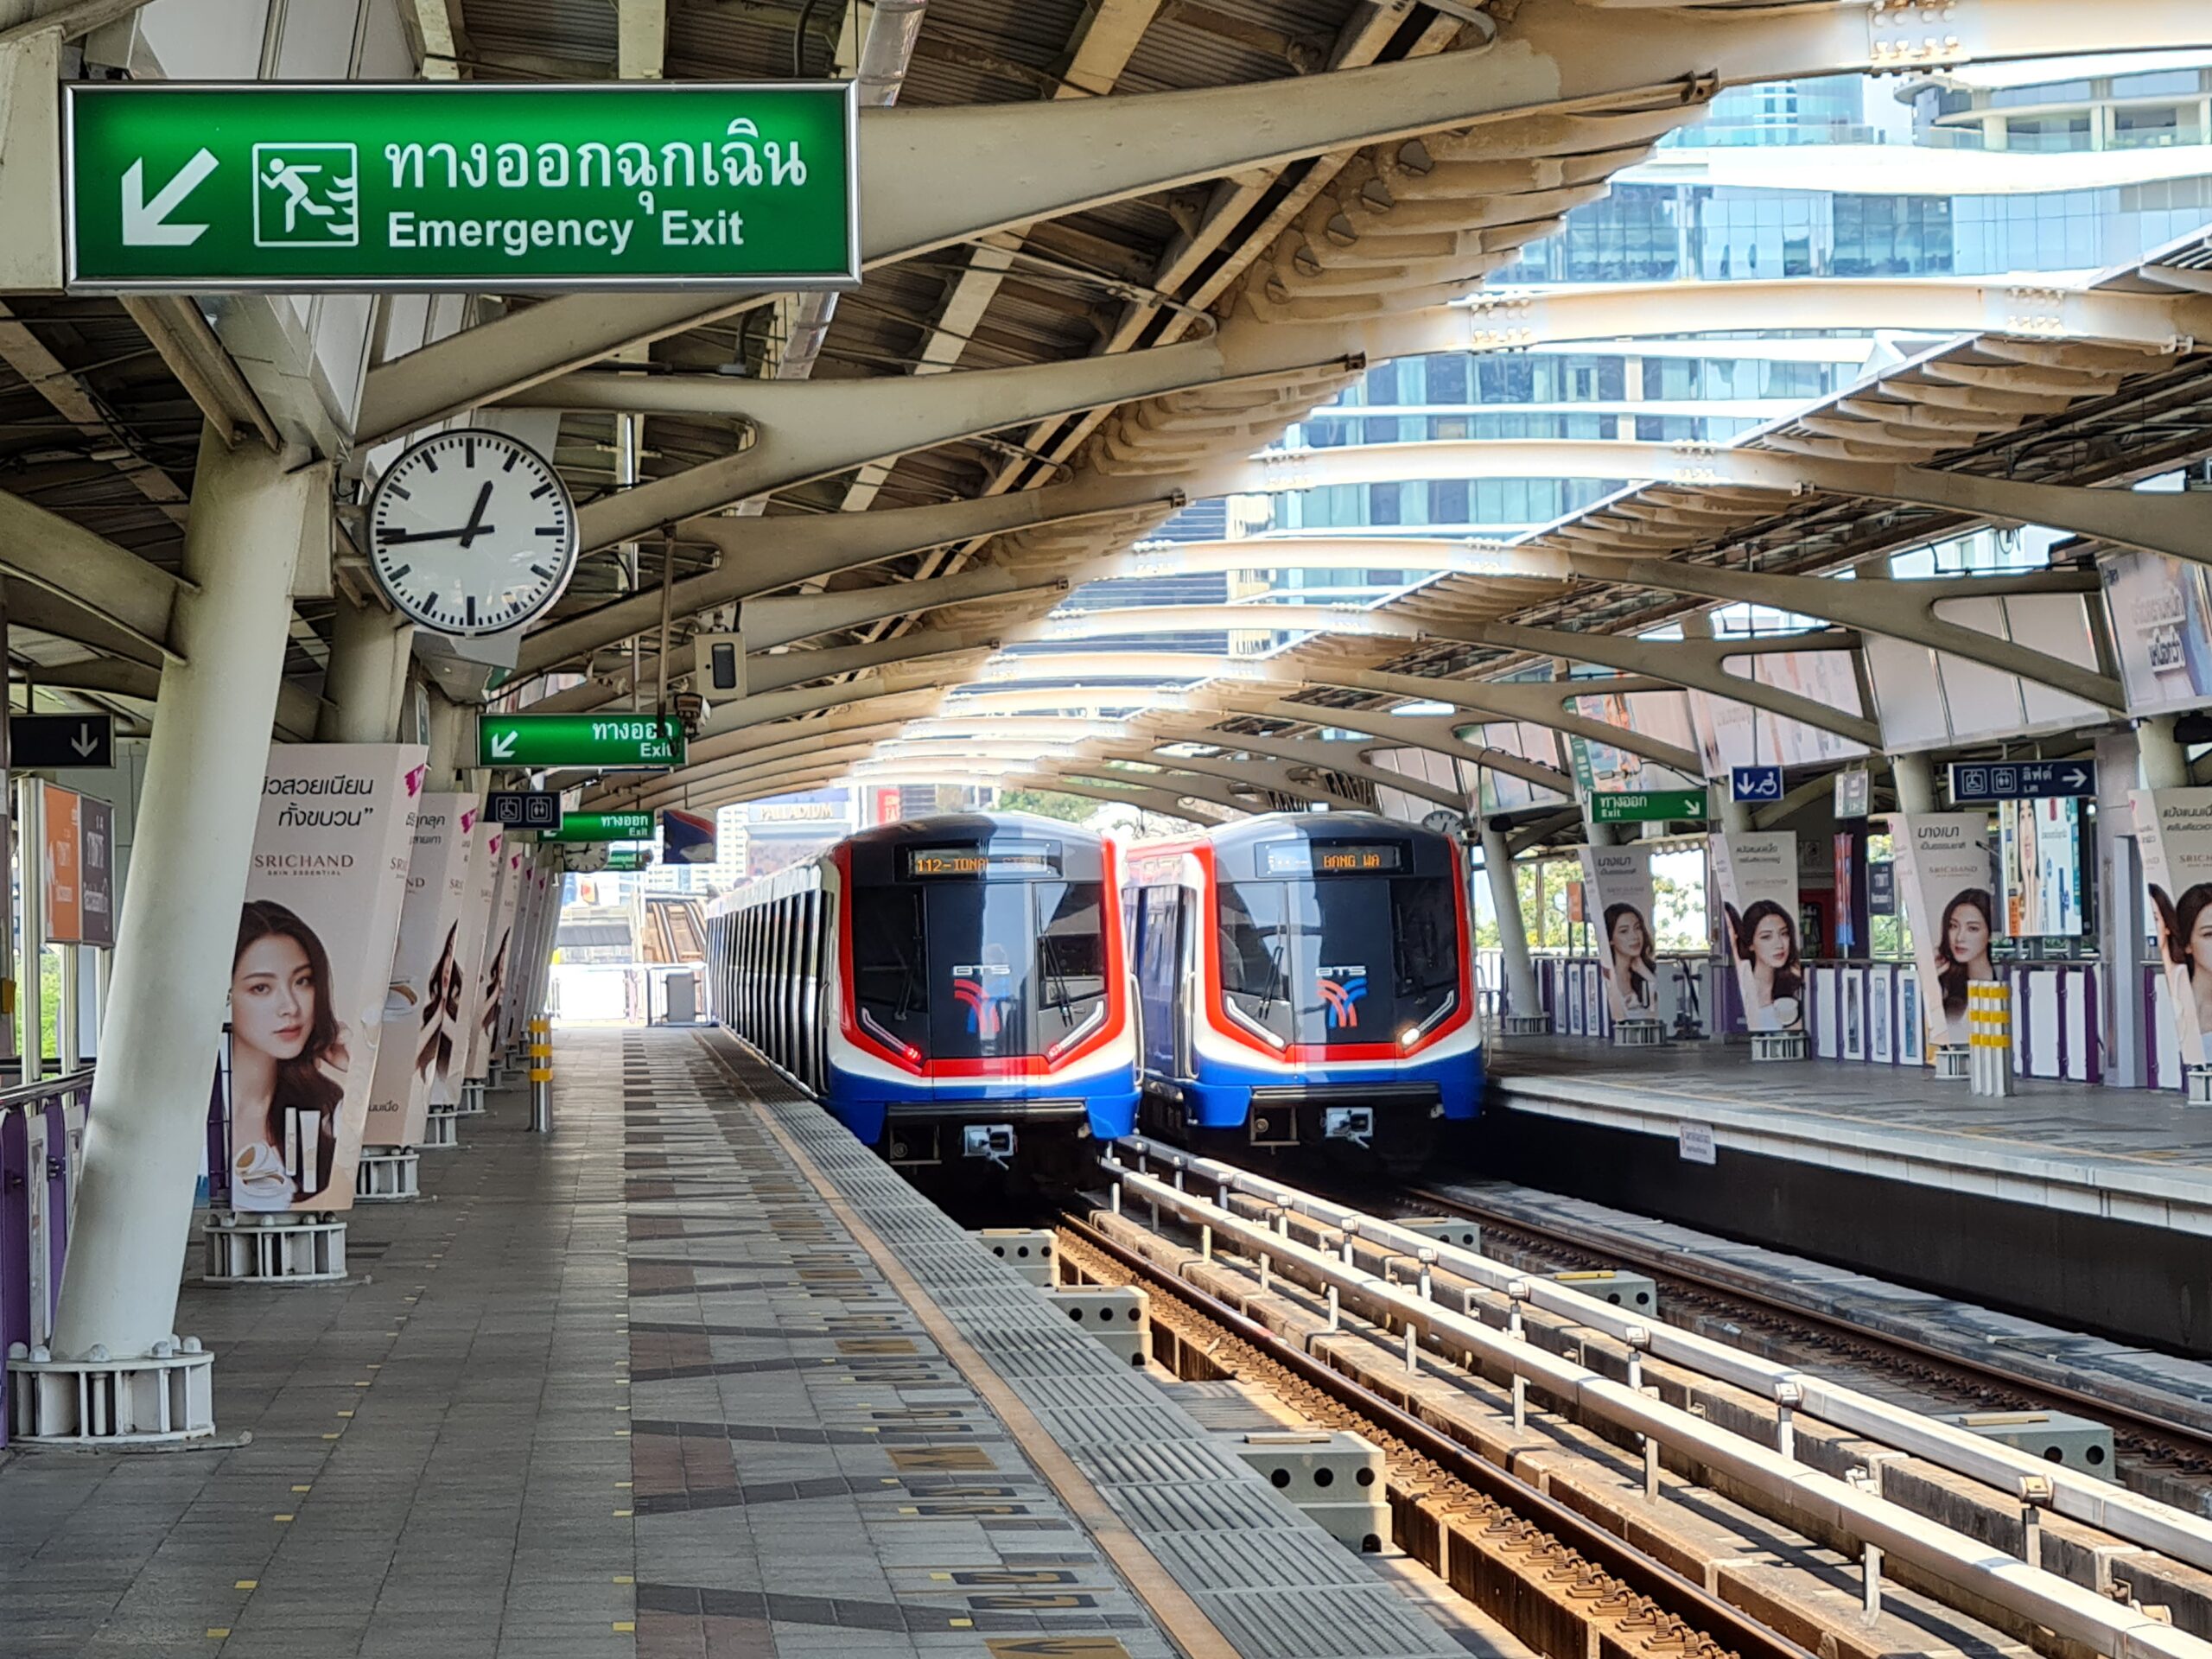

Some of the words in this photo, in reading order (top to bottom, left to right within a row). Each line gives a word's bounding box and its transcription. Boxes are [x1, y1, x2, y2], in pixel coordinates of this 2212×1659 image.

[385, 118, 807, 214] ทางออกฉุกเฉิน
[388, 211, 634, 257] Emergency
[660, 209, 744, 247] Exit
[640, 742, 673, 758] Exit
[1600, 796, 1648, 808] ทางออก
[760, 803, 833, 820] PALLADIUM
[1601, 809, 1622, 817] Exit
[601, 815, 649, 828] ทางออก
[628, 827, 648, 836] Exit
[254, 854, 354, 868] SRICHAND
[953, 964, 1010, 976] BTS
[1315, 966, 1366, 976] BTS
